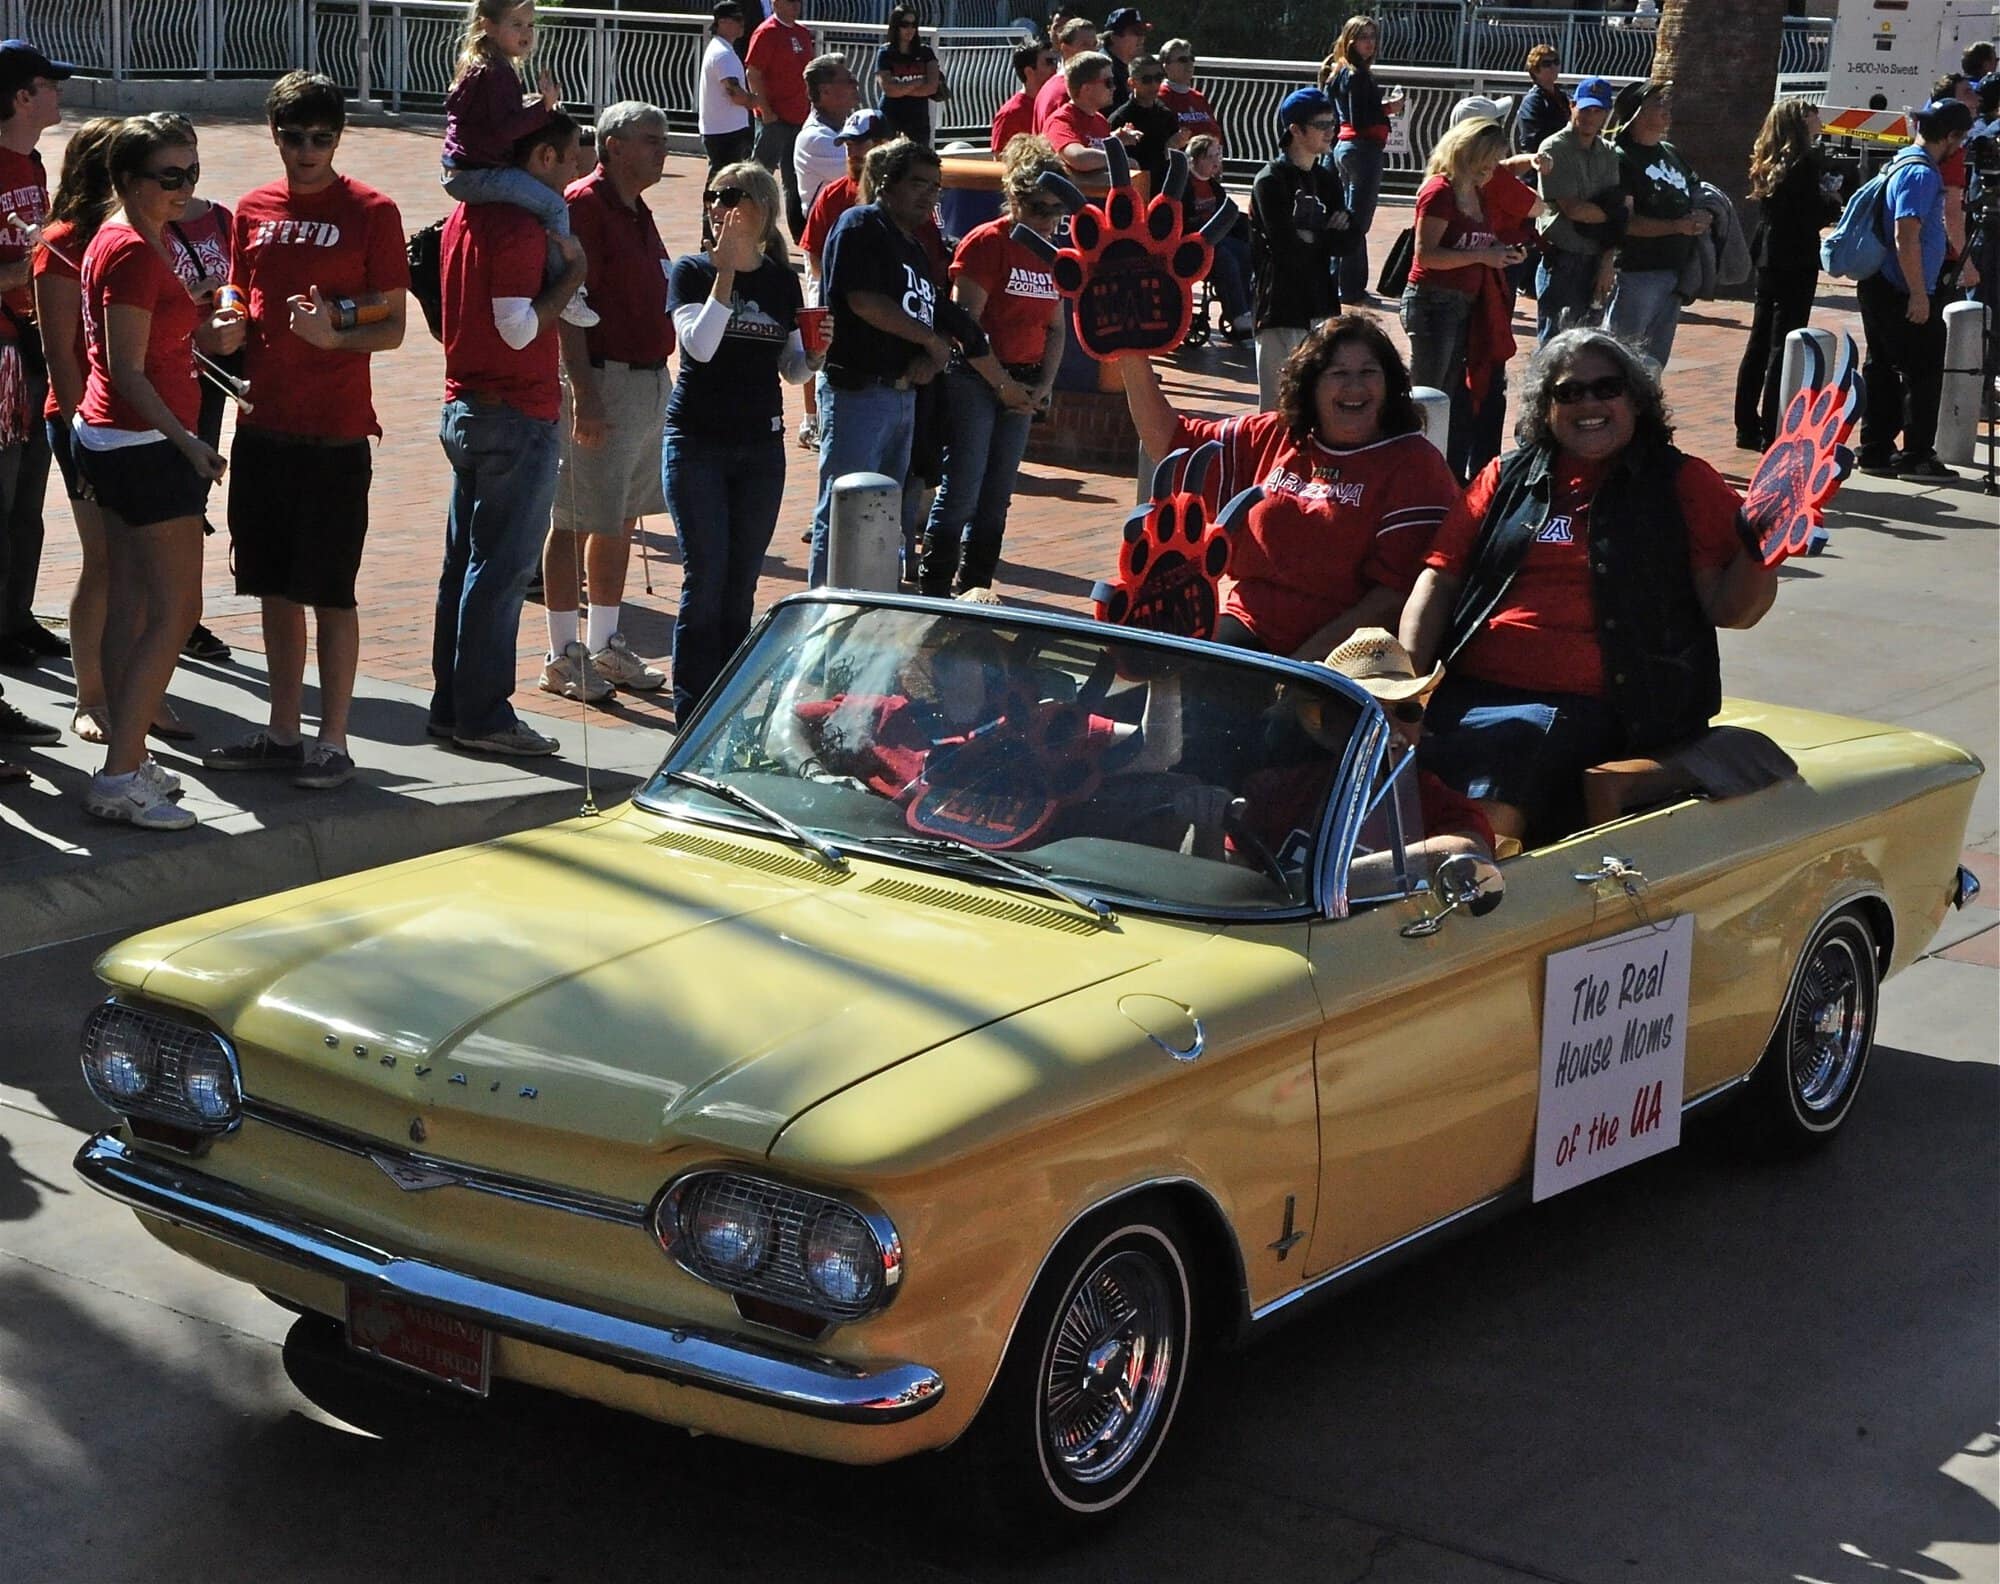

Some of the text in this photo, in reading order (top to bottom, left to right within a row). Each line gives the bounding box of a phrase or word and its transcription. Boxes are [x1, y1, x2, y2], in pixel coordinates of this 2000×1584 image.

[1262, 466, 1364, 507] ARIZONA
[1573, 950, 1669, 1025] The Real
[324, 1033, 539, 1099] CORVAIR
[1555, 1013, 1675, 1088] House Moms
[1556, 1080, 1664, 1168] of the UA
[406, 1305, 481, 1343] MARINE
